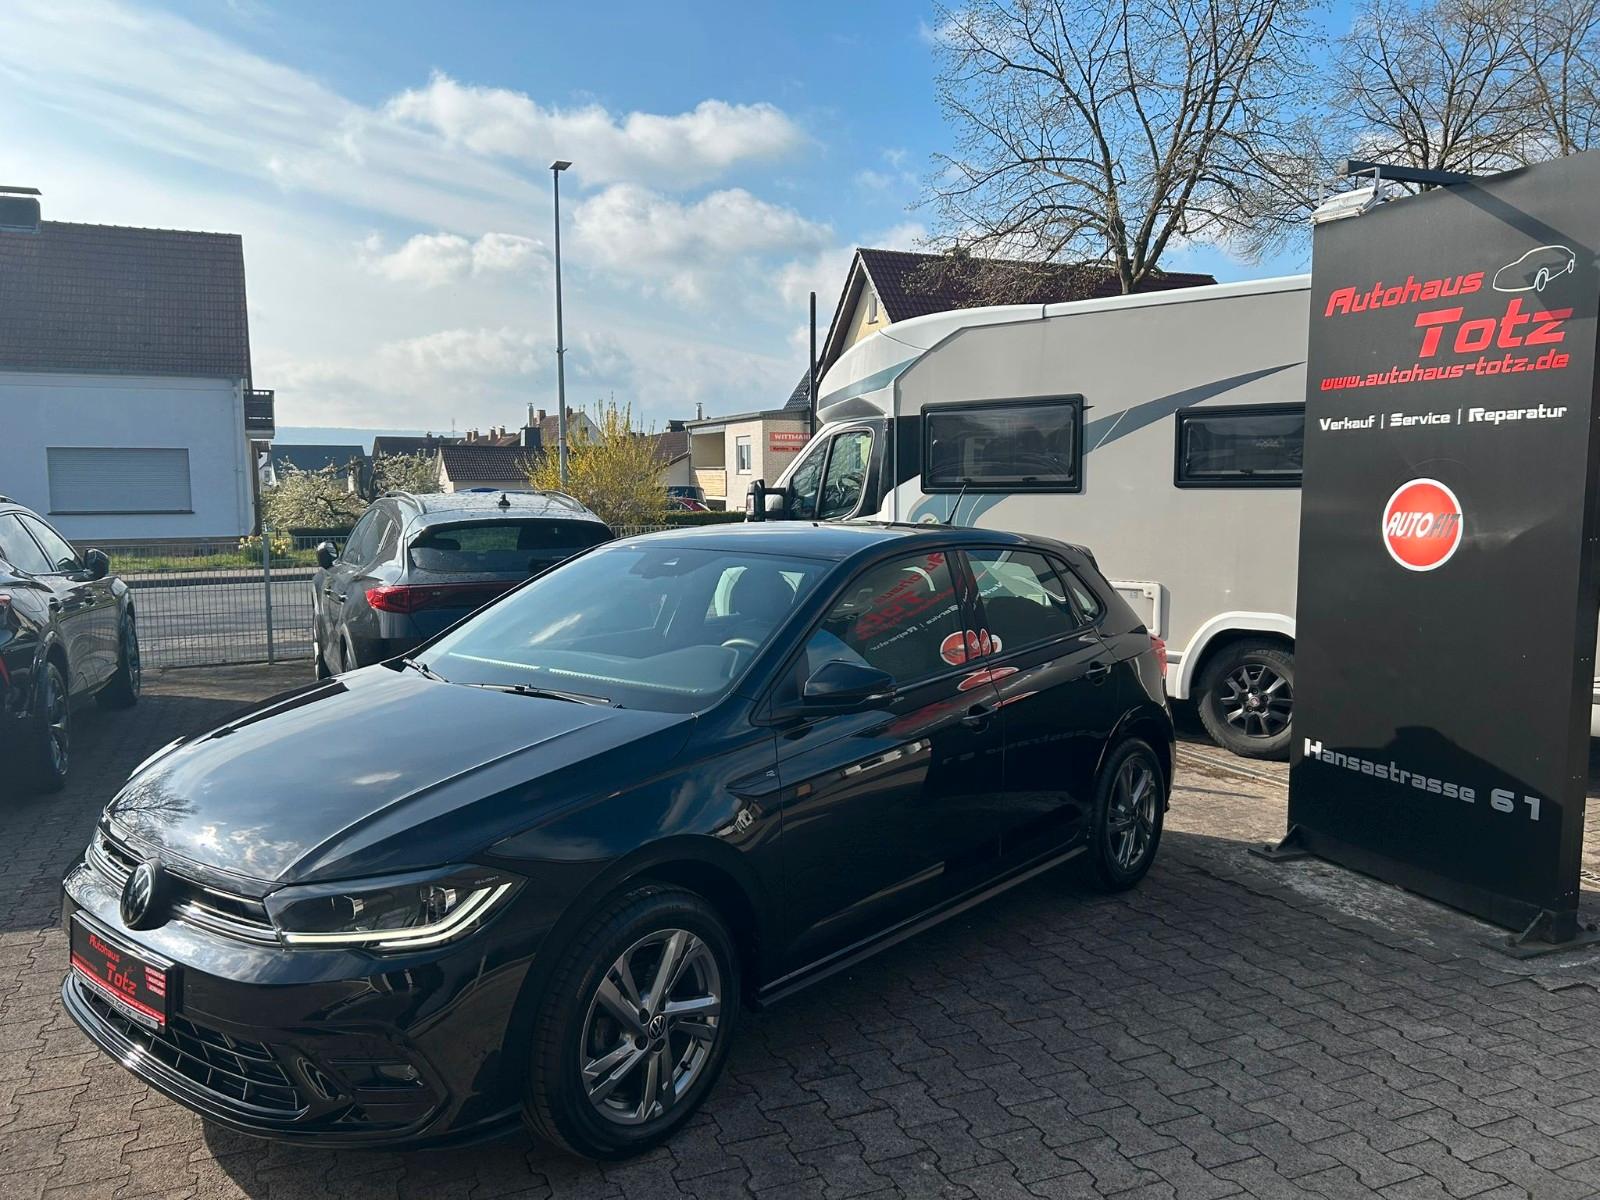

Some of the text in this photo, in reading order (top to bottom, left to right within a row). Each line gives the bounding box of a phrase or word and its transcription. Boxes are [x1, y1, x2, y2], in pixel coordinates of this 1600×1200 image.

[1324, 271, 1485, 317] Autohaus
[1415, 298, 1573, 358] Totz
[1320, 349, 1570, 391] www.autohaus-totz.de
[1319, 404, 1568, 431] Verkauf Service Reparatur
[1304, 737, 1476, 804] Hansastrasse
[89, 934, 120, 963] Autohaus
[106, 961, 137, 995] Totz
